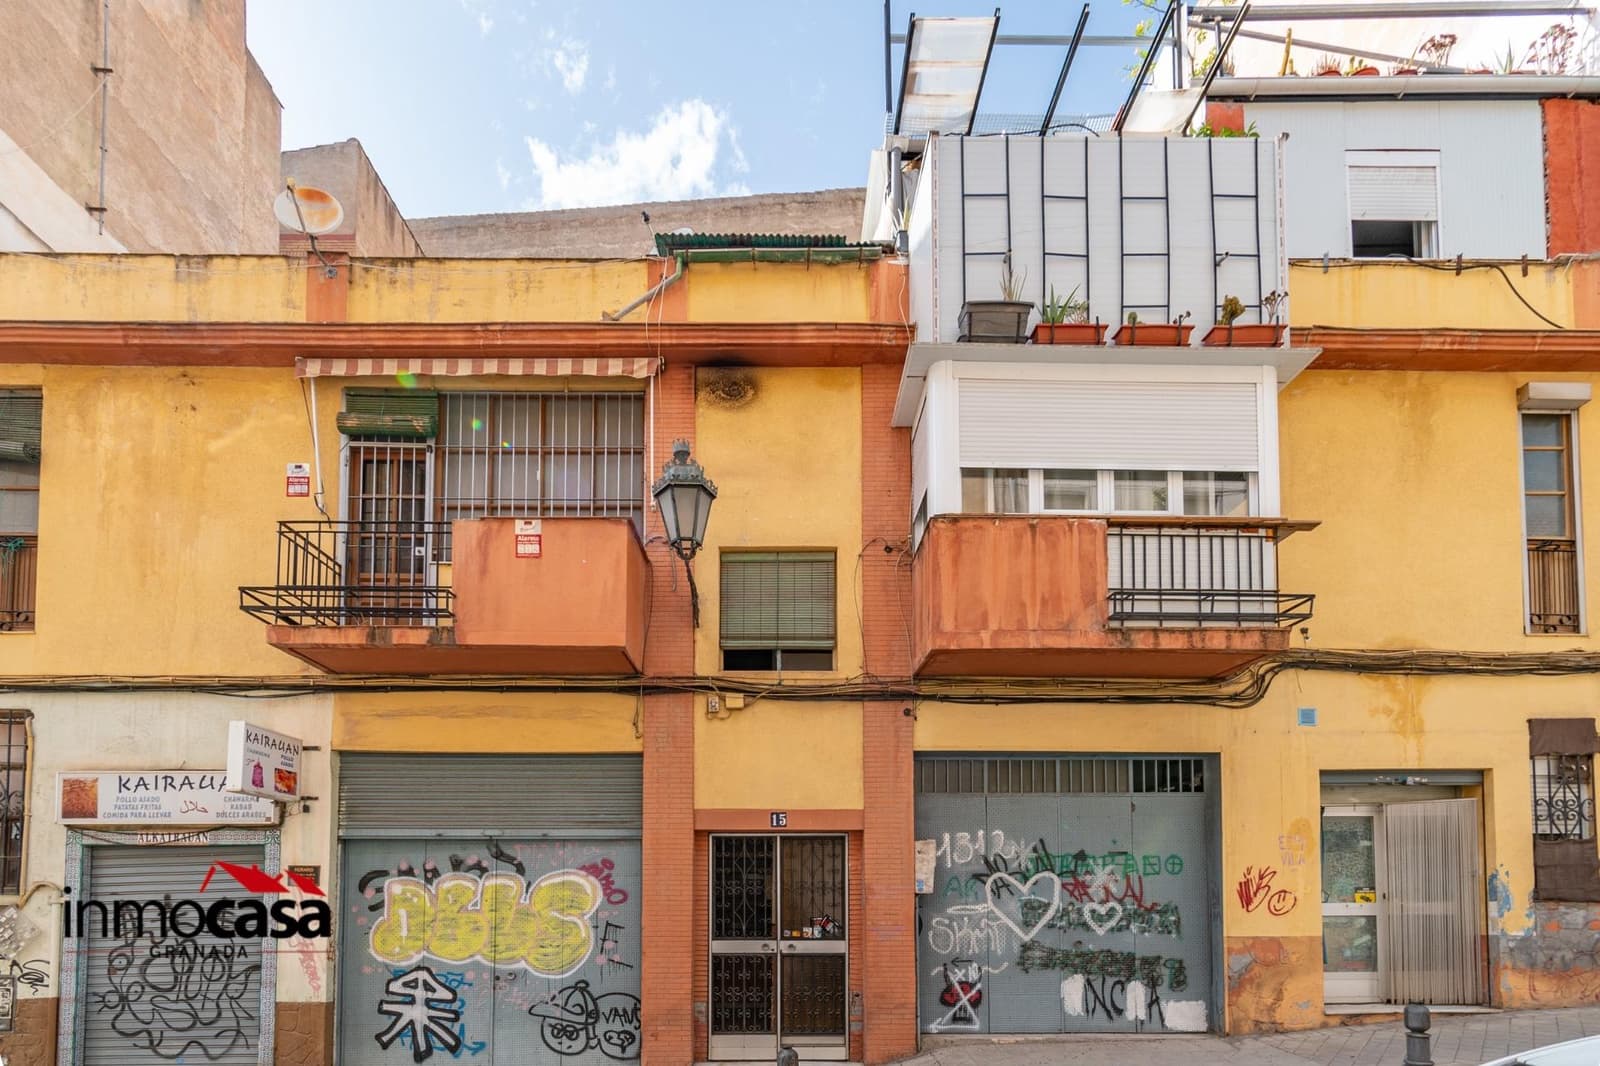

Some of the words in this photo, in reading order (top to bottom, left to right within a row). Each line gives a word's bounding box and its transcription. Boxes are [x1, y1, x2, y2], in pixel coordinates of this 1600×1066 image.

[245, 728, 300, 756] KAIRAUAN
[118, 775, 227, 793] KAIRAU
[771, 813, 787, 826] 15
